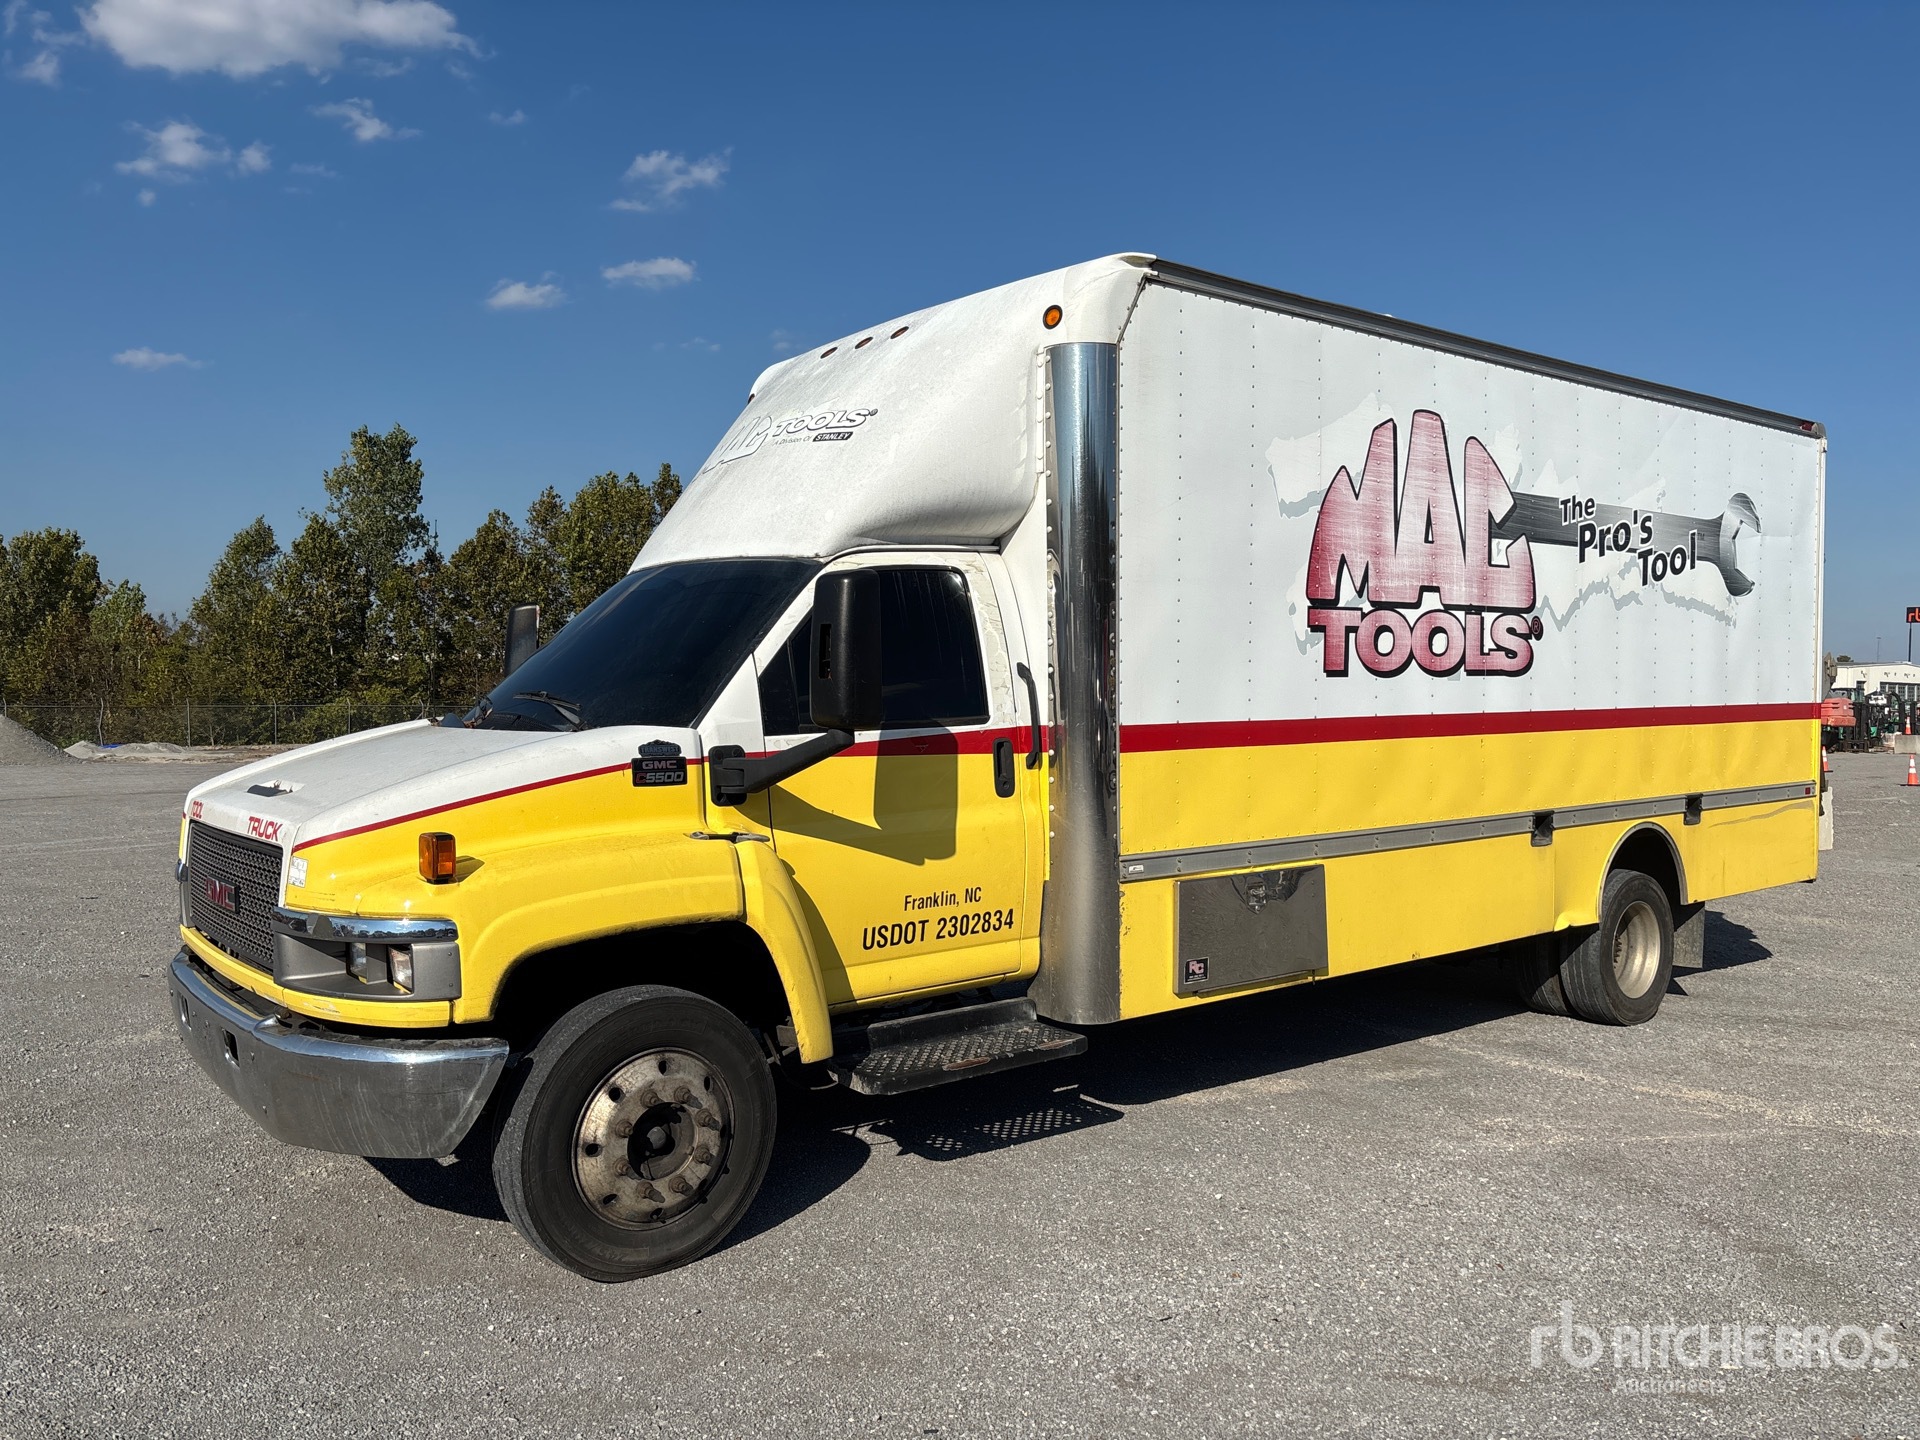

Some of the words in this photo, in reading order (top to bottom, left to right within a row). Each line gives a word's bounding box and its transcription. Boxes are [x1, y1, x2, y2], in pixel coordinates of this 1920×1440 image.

[815, 432, 851, 441] STANLEY
[1306, 409, 1537, 613] MAC
[1560, 494, 1596, 525] The
[1578, 509, 1654, 564] Pro's
[1637, 530, 1697, 587] Tool
[635, 771, 684, 784] C5500
[642, 760, 677, 769] GMC
[246, 816, 283, 841] TRUCK
[204, 878, 235, 910] GMC
[904, 890, 959, 911] Franklin,
[964, 886, 982, 903] NC
[862, 919, 929, 950] USDOT
[936, 908, 1014, 940] 2302834
